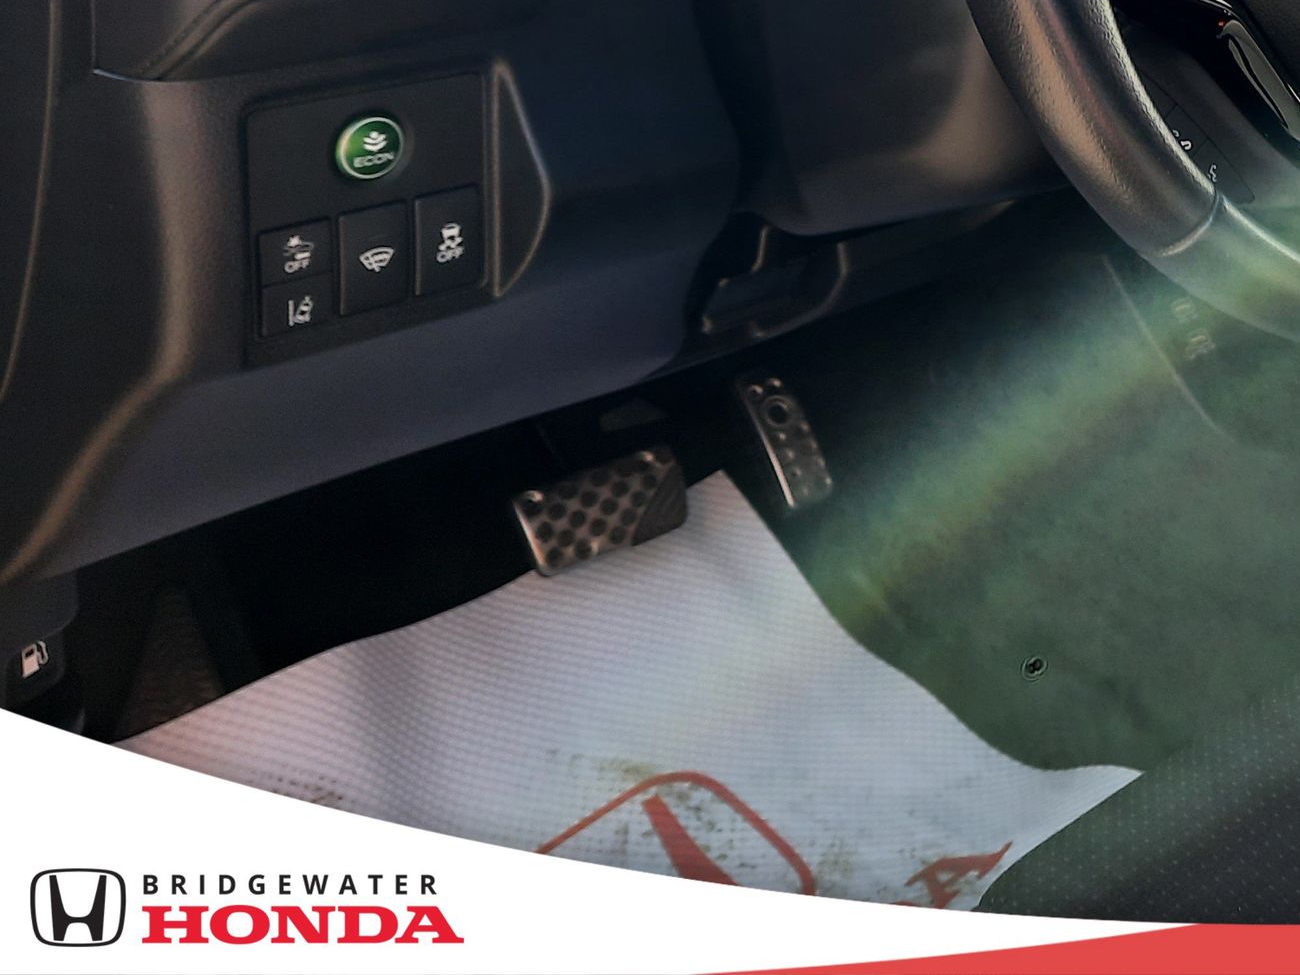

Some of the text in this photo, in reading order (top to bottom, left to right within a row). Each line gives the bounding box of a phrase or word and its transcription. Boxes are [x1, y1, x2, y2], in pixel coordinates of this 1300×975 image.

[353, 152, 394, 168] ECON
[436, 246, 464, 263] OFF
[284, 258, 310, 274] OFF
